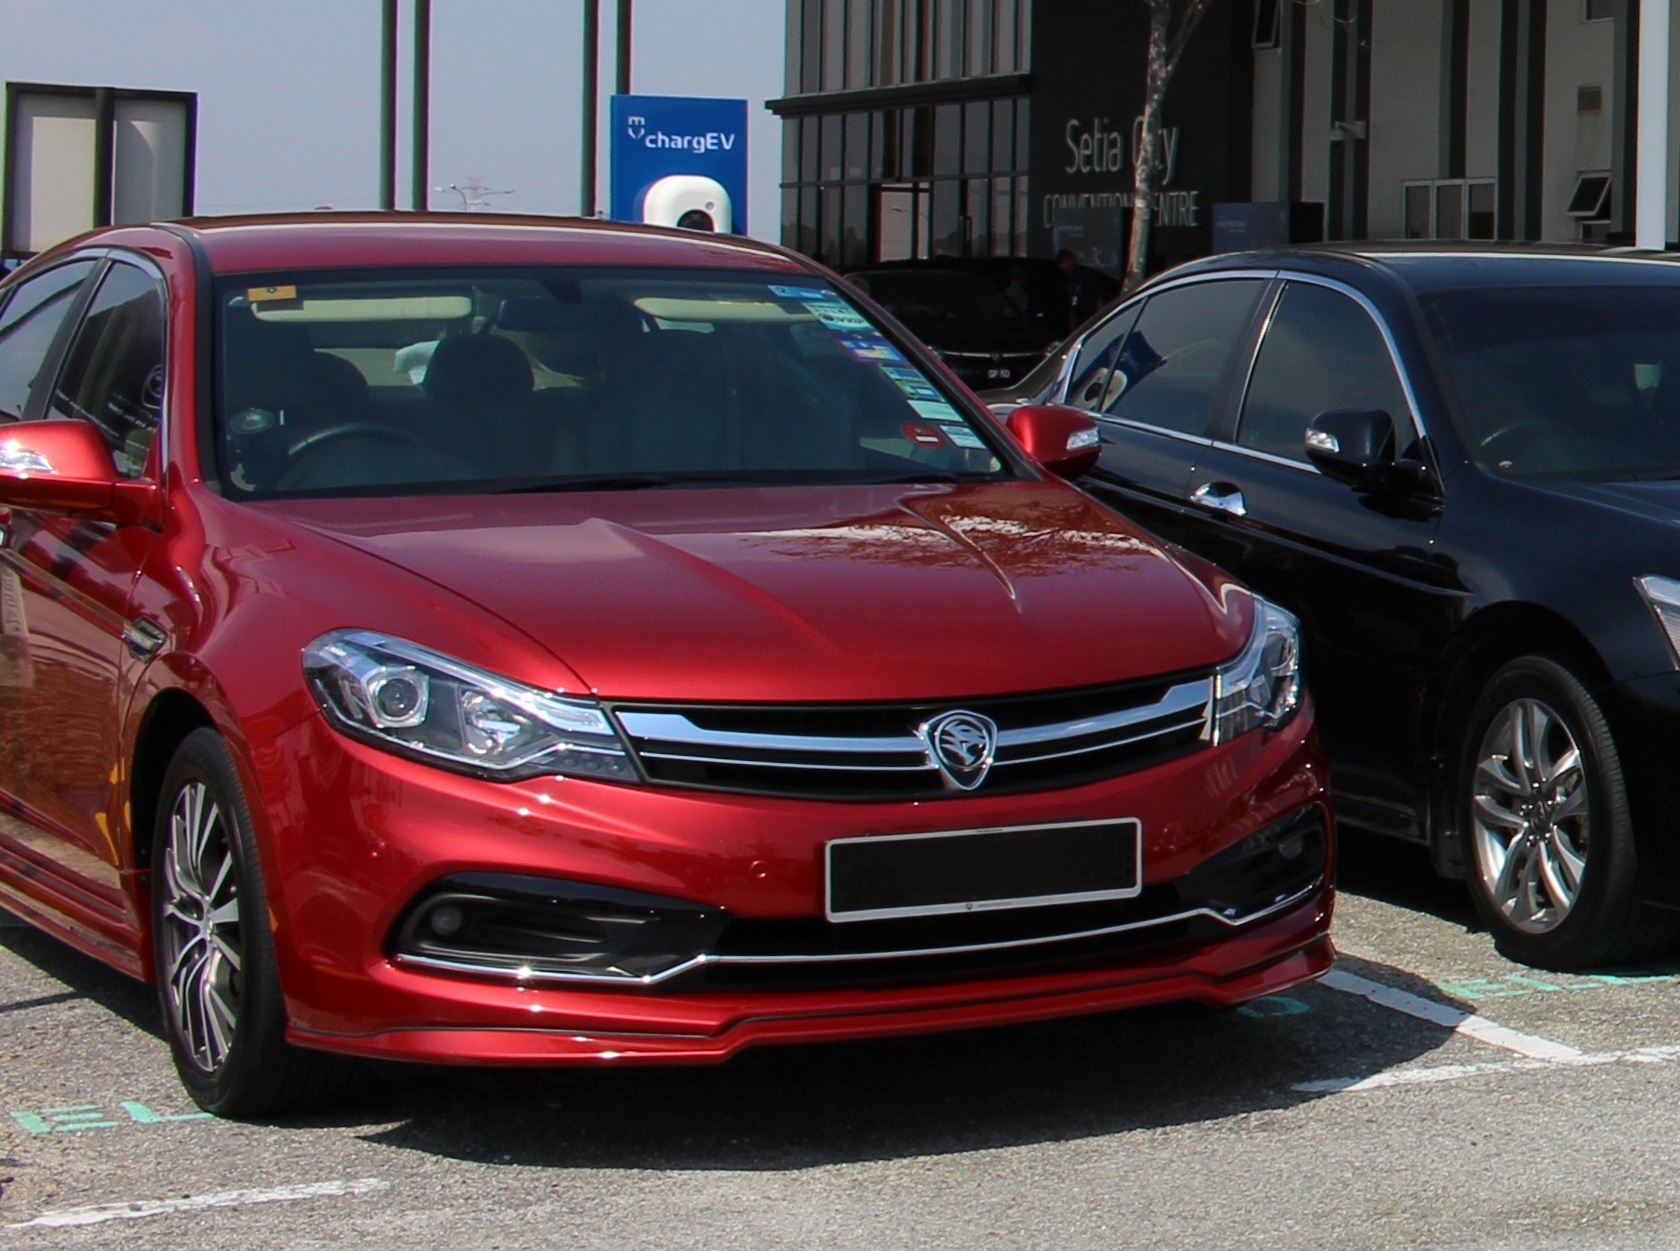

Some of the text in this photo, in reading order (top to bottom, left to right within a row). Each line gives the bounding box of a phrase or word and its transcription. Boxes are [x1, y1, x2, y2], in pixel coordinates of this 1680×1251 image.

[645, 131, 735, 153] chargEV
[1065, 115, 1178, 186] Setia Cy
